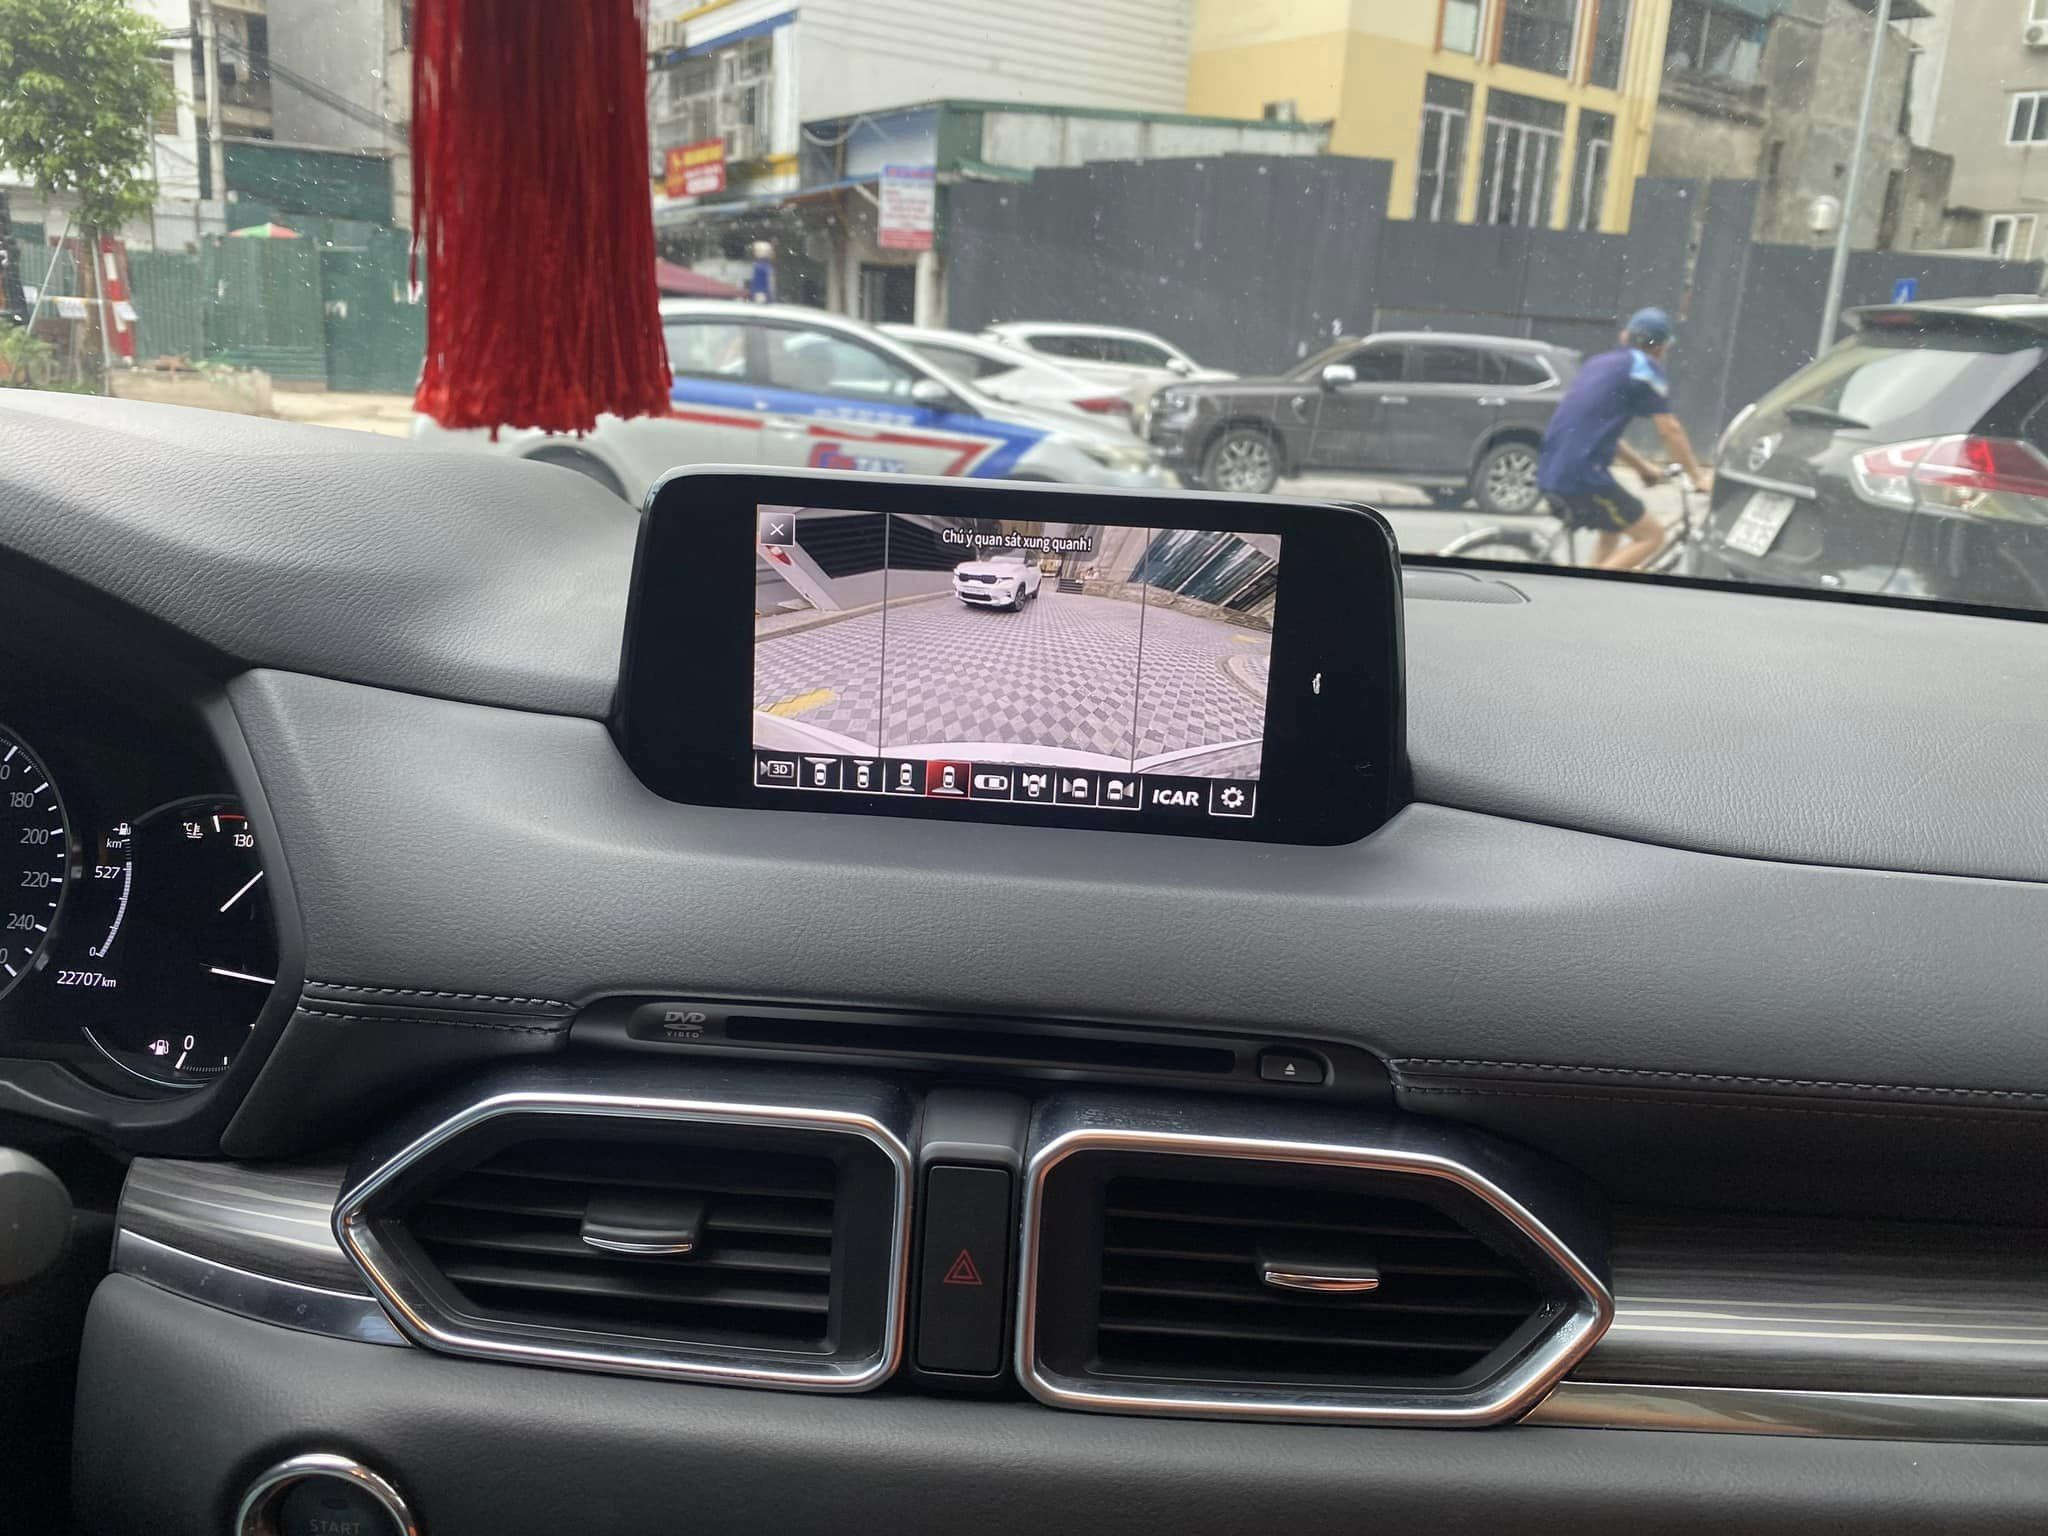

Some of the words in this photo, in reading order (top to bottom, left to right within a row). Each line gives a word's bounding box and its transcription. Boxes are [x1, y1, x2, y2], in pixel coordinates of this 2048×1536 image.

[942, 529, 964, 543] Chú
[966, 530, 973, 548] ý
[974, 535, 1003, 548] quan
[1004, 532, 1022, 547] sát
[1023, 538, 1050, 552] xung
[1052, 537, 1092, 552] quanh!
[772, 762, 789, 775] 3D
[9, 792, 34, 808] 180
[1152, 789, 1200, 808] ICAR
[20, 828, 49, 844] 200
[106, 838, 122, 849] km
[233, 834, 254, 848] 130
[21, 871, 49, 888] 220
[94, 865, 120, 879] 527
[6, 913, 35, 930] 240
[89, 946, 97, 957] 0
[57, 970, 102, 987] 22707
[101, 977, 117, 988] km
[664, 1012, 705, 1023] DVD
[184, 1035, 194, 1050] 0
